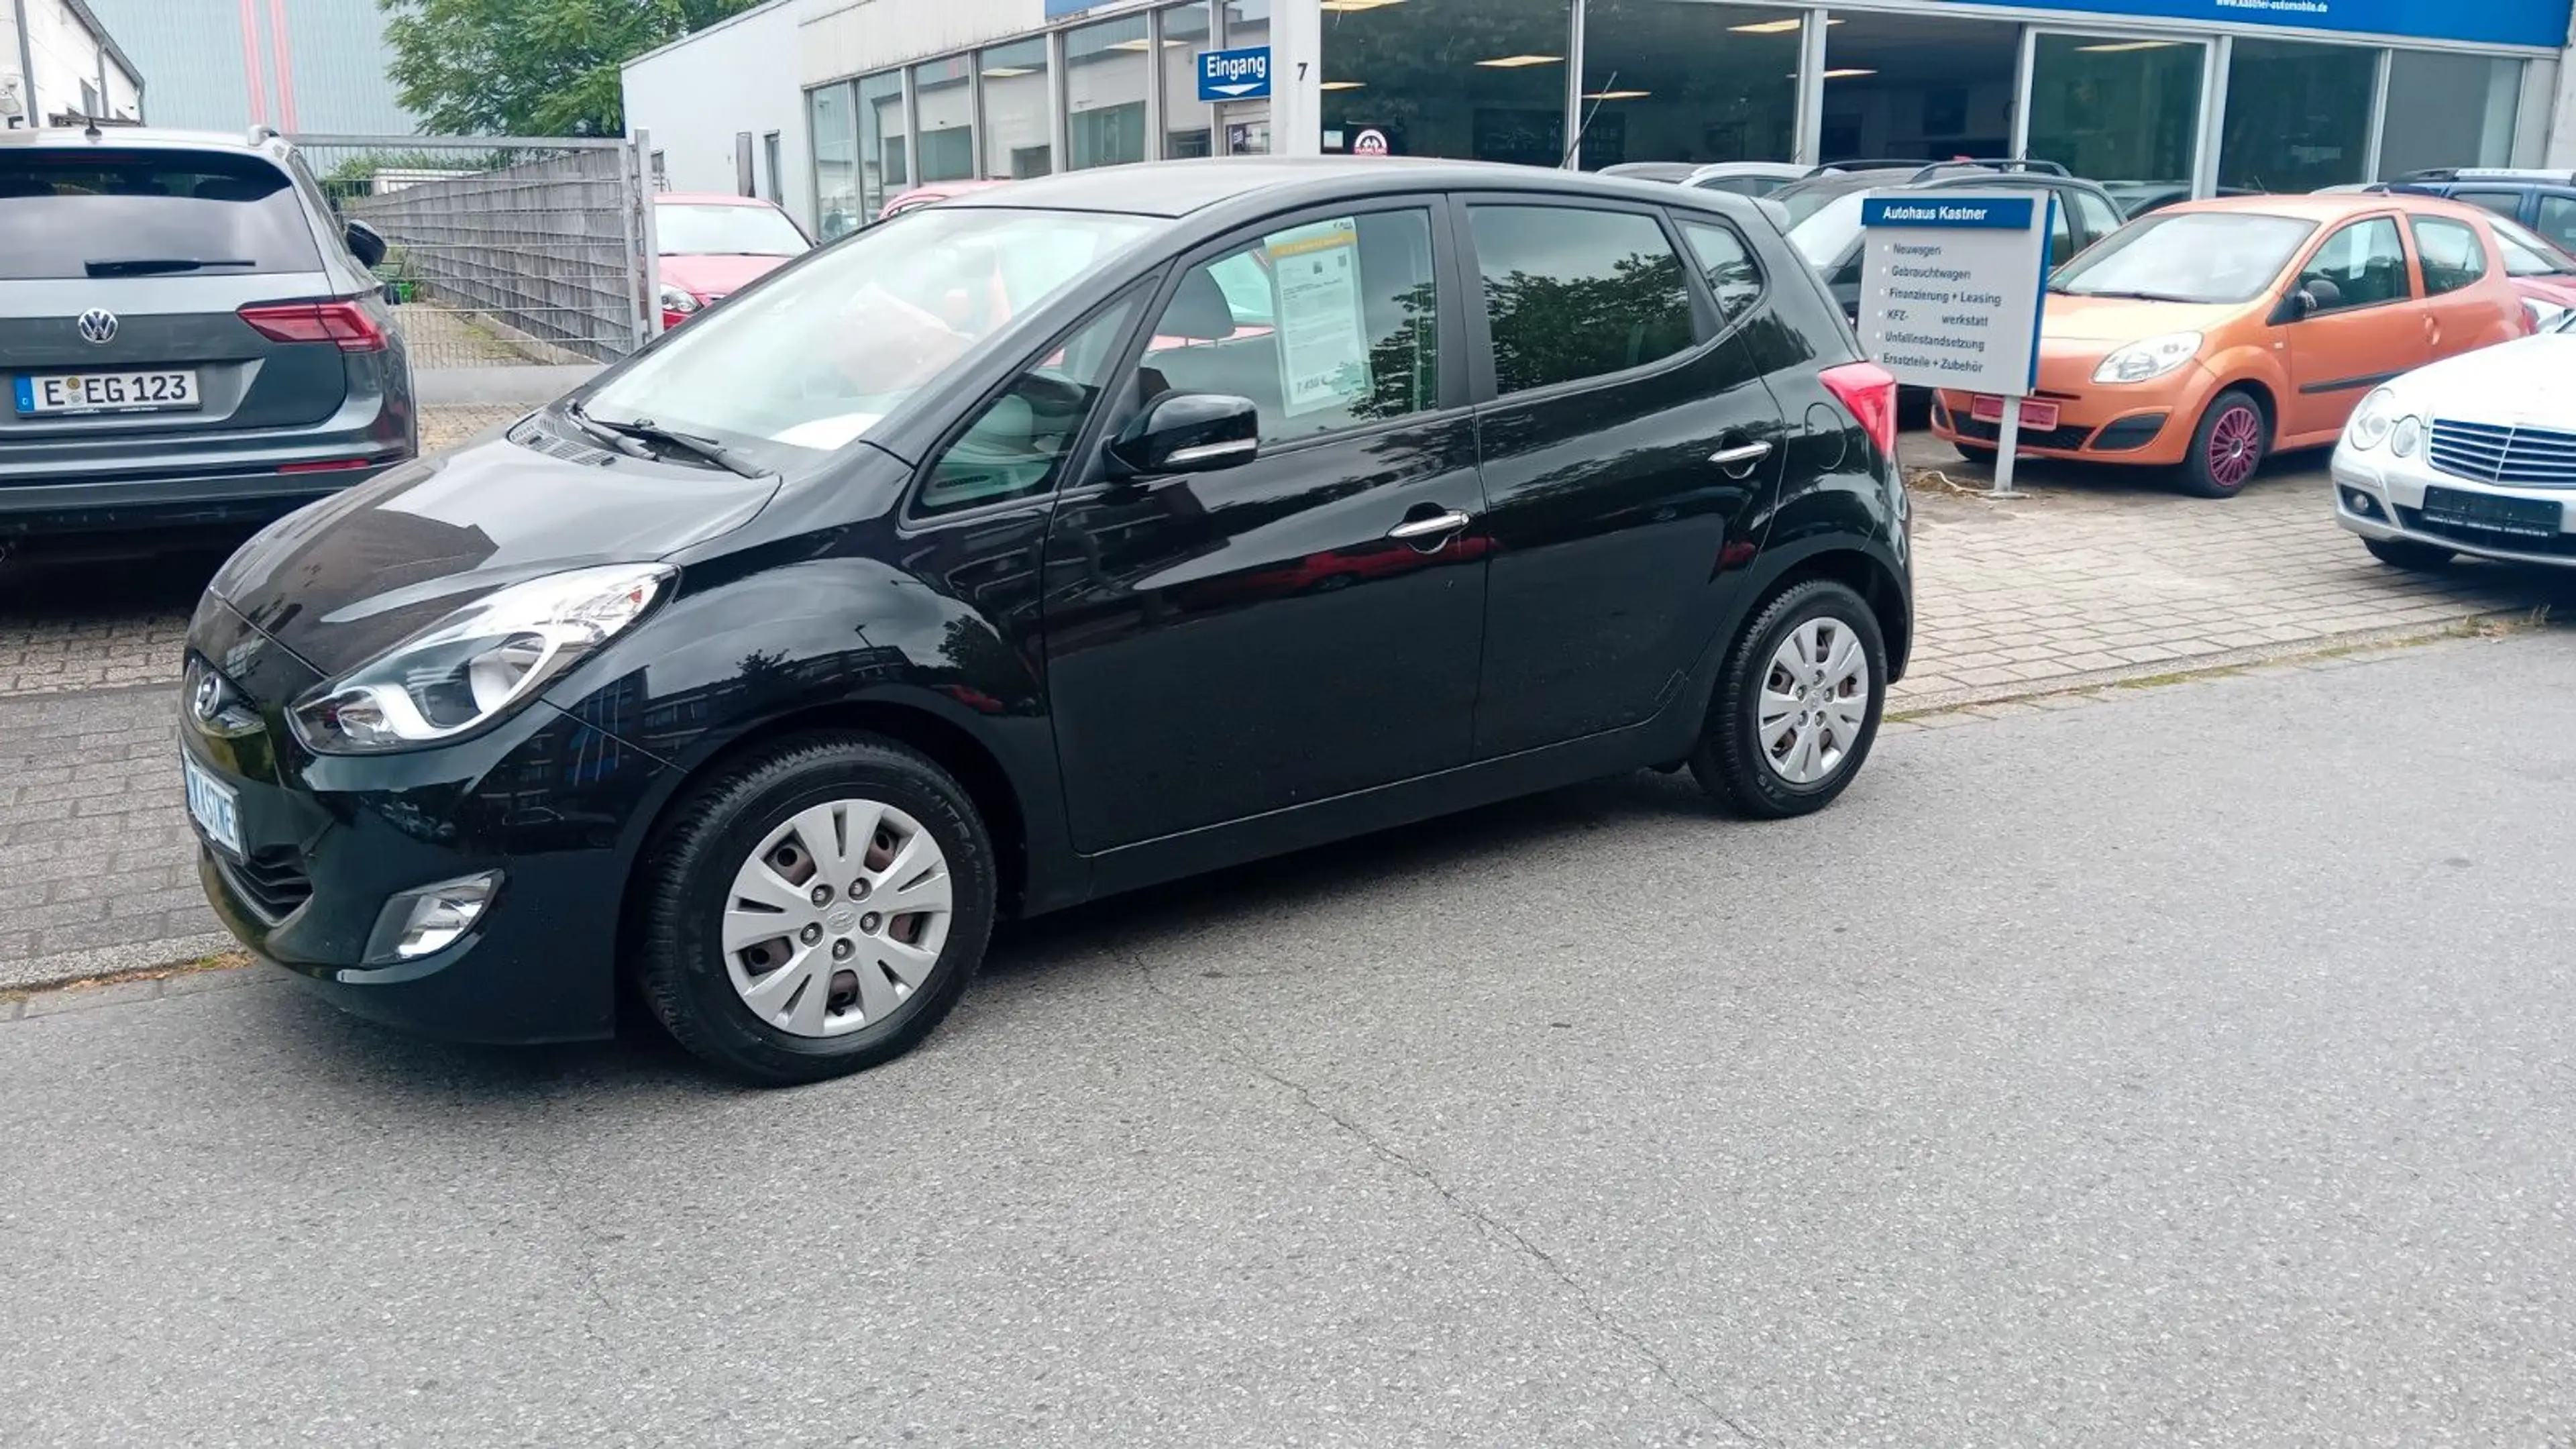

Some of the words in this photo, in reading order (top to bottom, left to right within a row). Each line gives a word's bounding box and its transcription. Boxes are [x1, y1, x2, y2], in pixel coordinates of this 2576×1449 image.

[1207, 56, 1266, 80] Eingang
[1297, 62, 1308, 81] 7
[1882, 206, 1936, 220] Autohaus
[1939, 206, 1988, 220] Kastner
[1893, 243, 1941, 258] Neuwagen
[1892, 265, 1971, 281] Gebrauchtwagen
[1889, 288, 1949, 303] Finanzierung
[1960, 292, 2002, 307] Leasing
[1941, 314, 1988, 327] werkstatt
[1885, 331, 1985, 352] Unfallinstandsetzung
[1883, 352, 1930, 368] Ersatzteile
[1940, 358, 1984, 372] Zubehör
[44, 380, 66, 406] E
[85, 377, 125, 403] EG
[131, 374, 187, 402] 123
